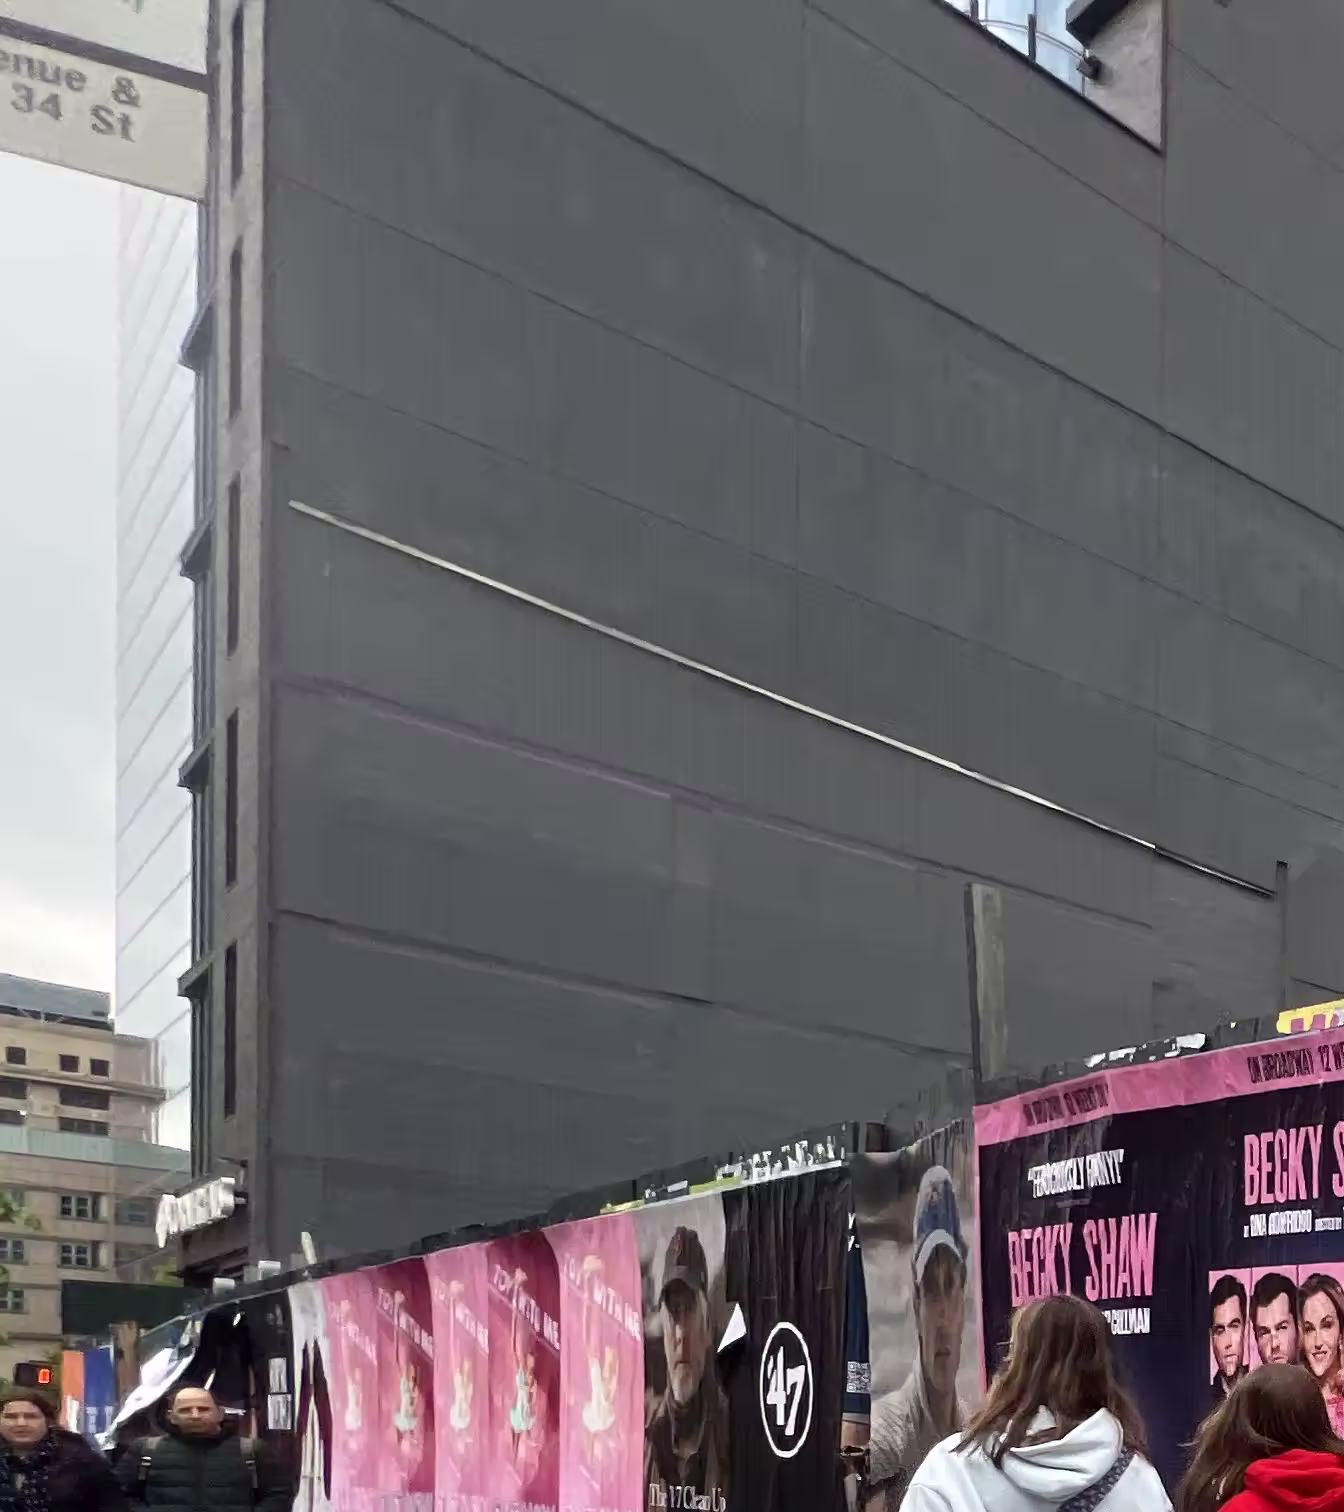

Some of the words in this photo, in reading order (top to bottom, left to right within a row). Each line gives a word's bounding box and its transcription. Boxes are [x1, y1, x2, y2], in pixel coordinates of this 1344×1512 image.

[10, 82, 63, 121] 34
[90, 104, 135, 142] St
[111, 76, 141, 107] &
[1318, 1044, 1332, 1072] 12
[1243, 1124, 1323, 1206] BECKY
[1008, 1222, 1073, 1308] BECKY
[1083, 1212, 1158, 1302] SHAW
